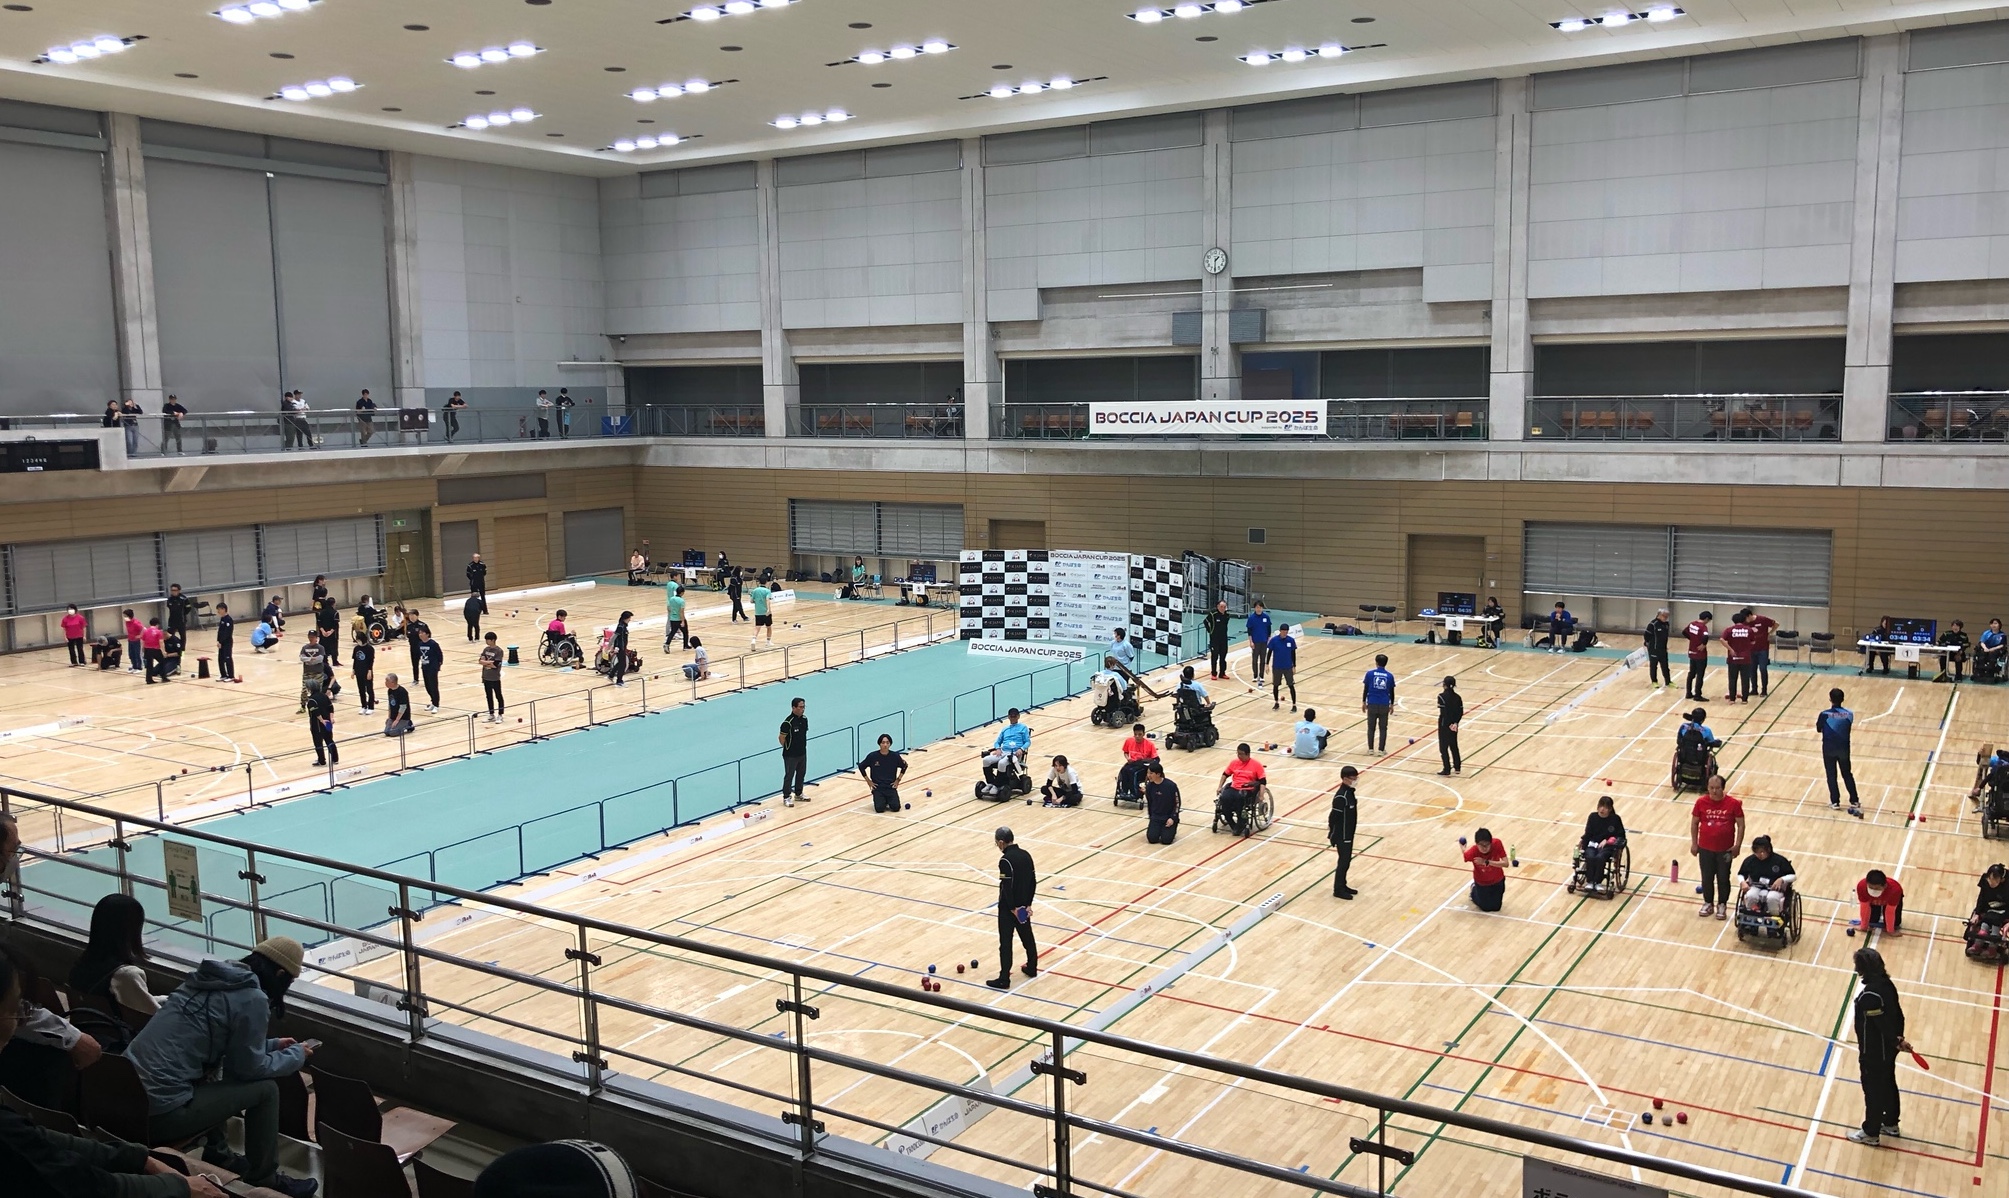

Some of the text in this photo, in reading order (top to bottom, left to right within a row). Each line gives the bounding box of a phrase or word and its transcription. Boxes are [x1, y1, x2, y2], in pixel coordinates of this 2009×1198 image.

[1095, 410, 1319, 424] BOCCIA JAPAN CUP 2025
[971, 643, 1004, 652] BOCCIA
[1005, 646, 1036, 655] JAPAN
[1552, 1167, 1578, 1176] BOCCIA
